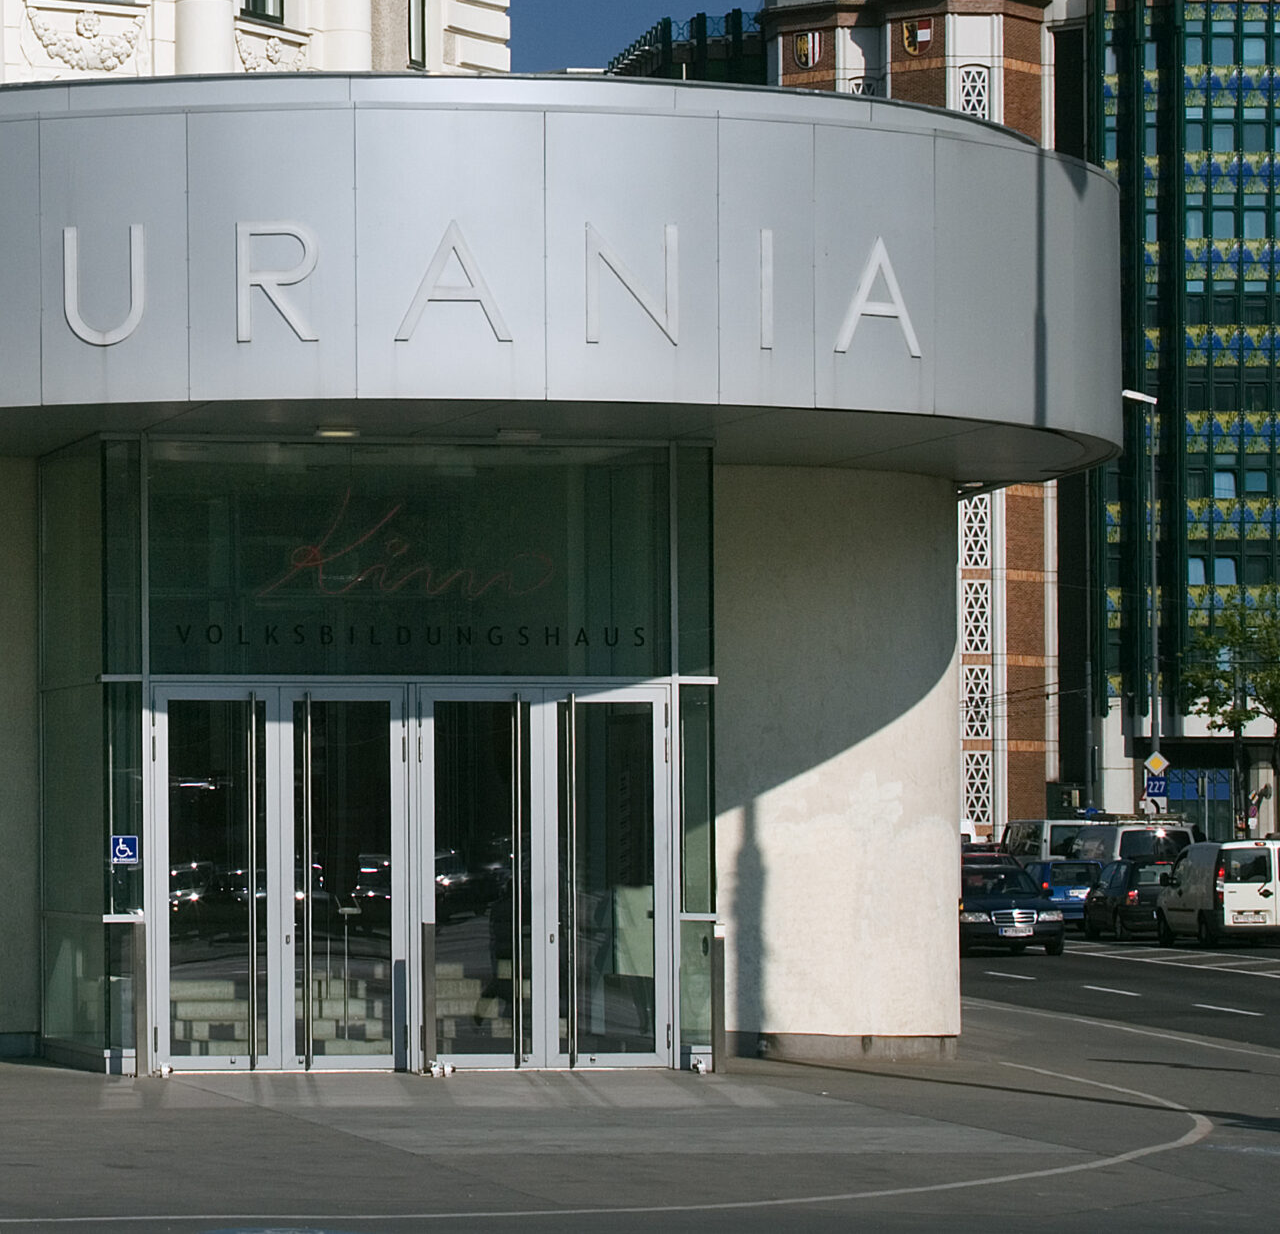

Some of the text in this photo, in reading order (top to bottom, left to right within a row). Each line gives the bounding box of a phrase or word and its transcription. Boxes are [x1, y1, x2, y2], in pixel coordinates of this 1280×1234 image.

[62, 218, 923, 359] URANIA
[253, 486, 555, 600] Kino
[175, 624, 646, 647] VOLKSBILDUNGSHAUS
[1148, 780, 1166, 794] 227
